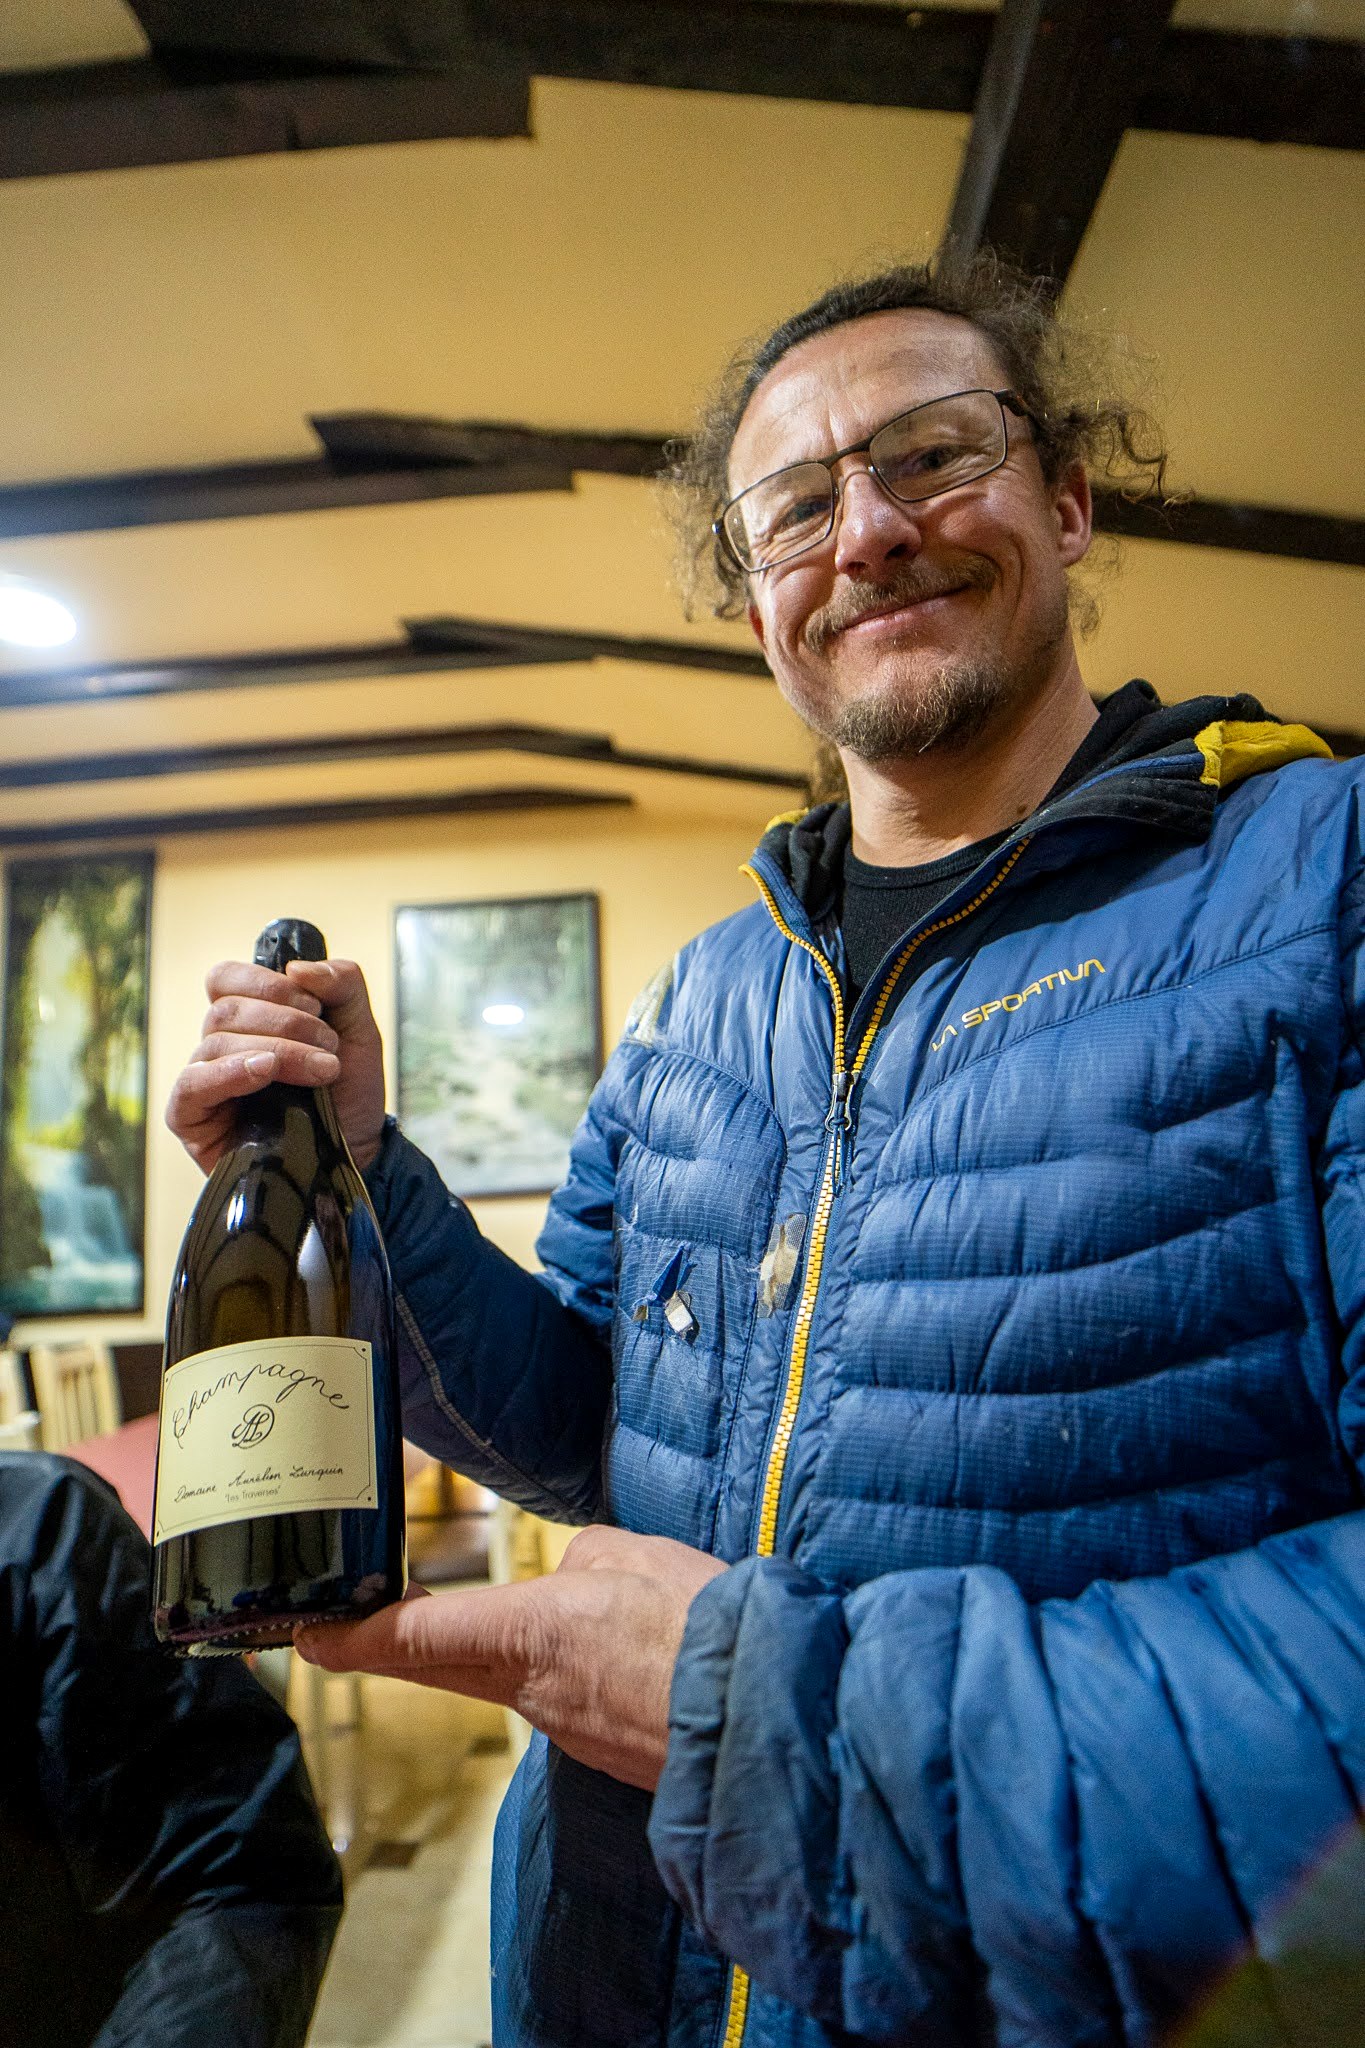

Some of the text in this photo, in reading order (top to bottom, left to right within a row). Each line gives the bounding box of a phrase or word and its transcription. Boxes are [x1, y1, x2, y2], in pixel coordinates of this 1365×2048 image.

[932, 958, 1106, 1052] LA SPORTIVA
[173, 1363, 349, 1449] Champagne
[174, 1485, 216, 1503] Domaine
